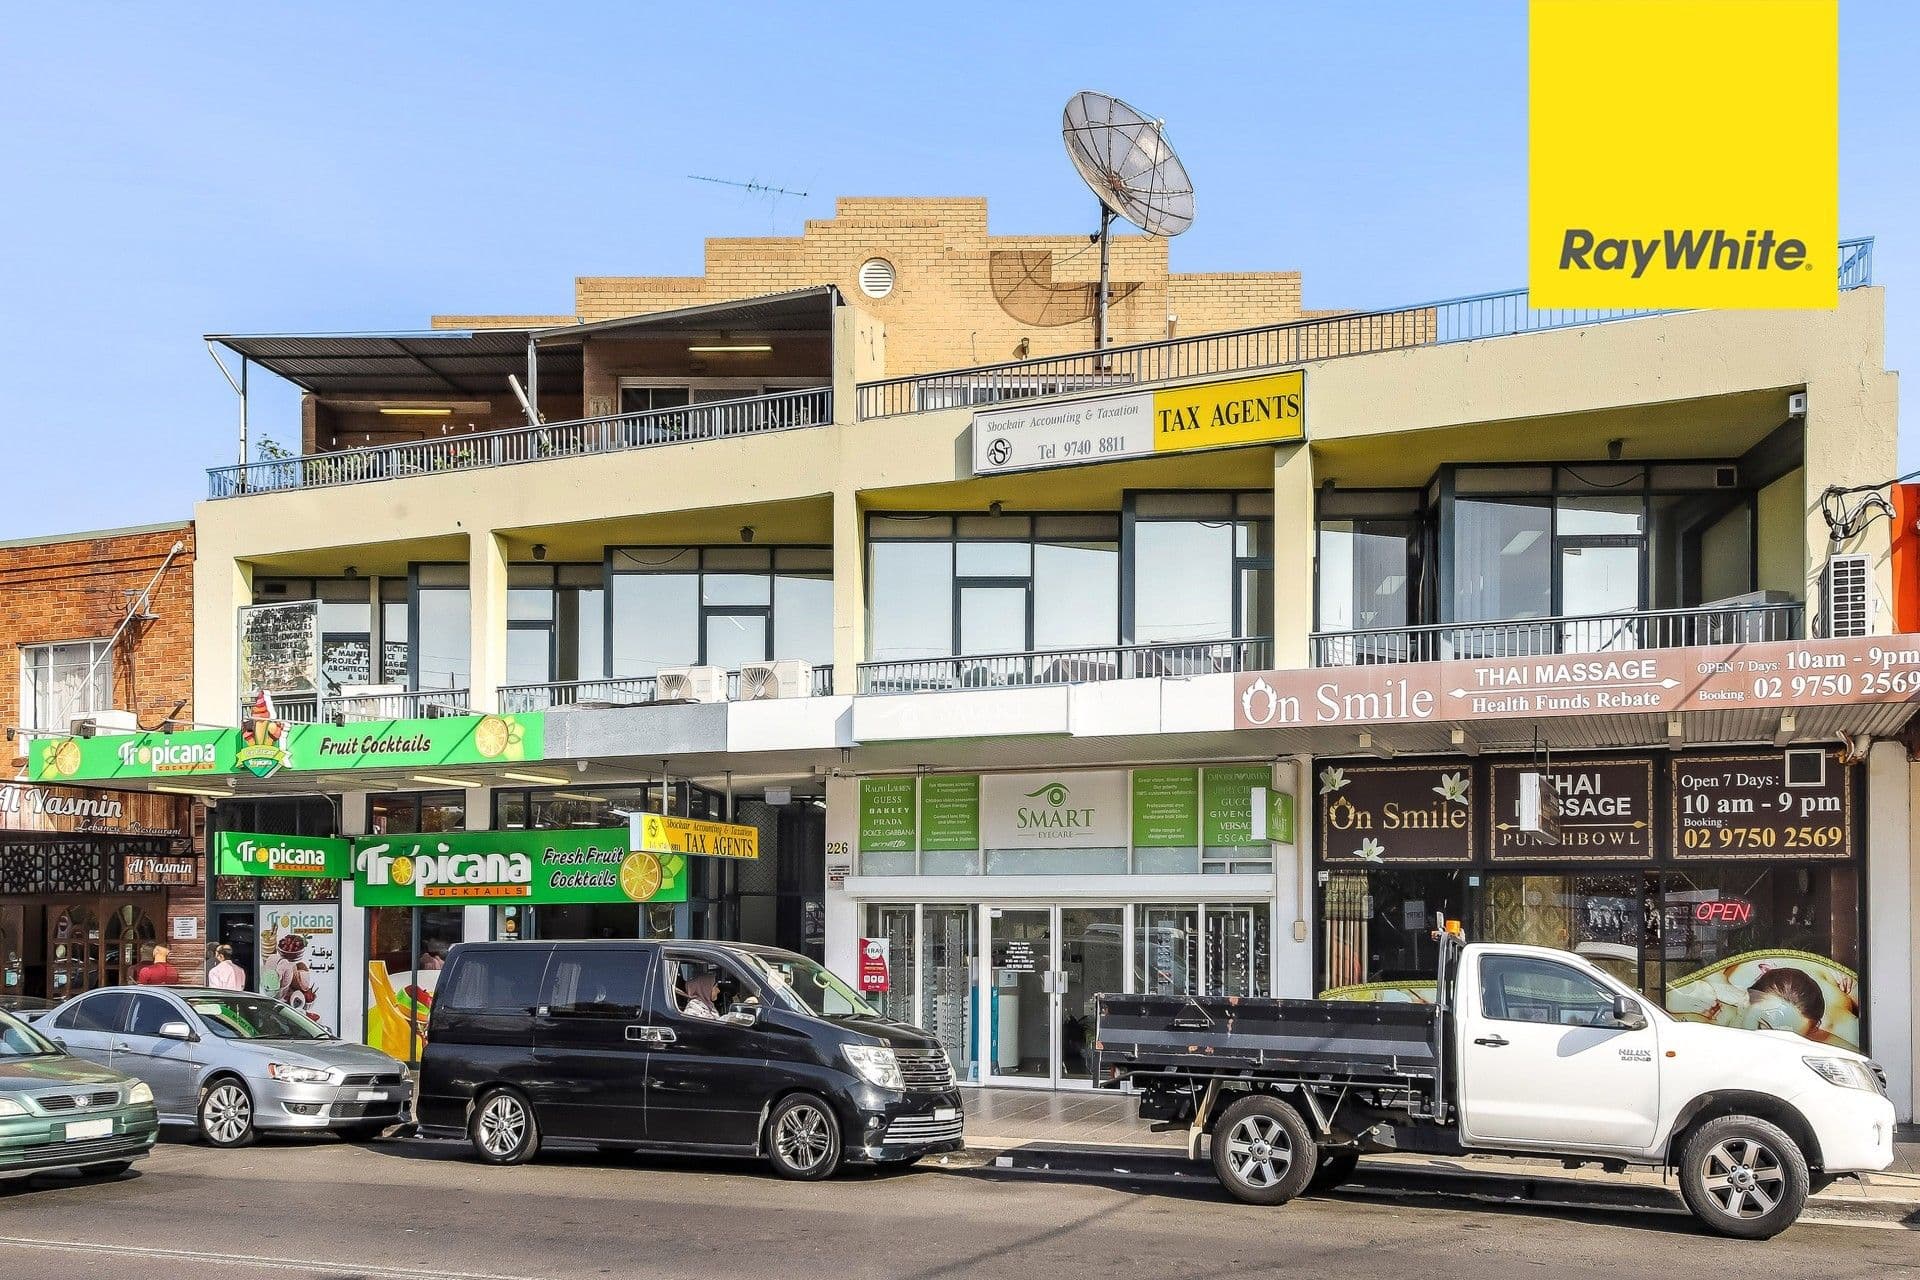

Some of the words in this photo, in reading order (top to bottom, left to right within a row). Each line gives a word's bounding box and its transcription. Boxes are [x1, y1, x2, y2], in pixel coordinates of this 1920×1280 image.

[986, 418, 1026, 433] Shockair
[1029, 411, 1082, 428] Accounting
[1085, 409, 1093, 420] &
[1097, 404, 1139, 420] Taxation
[1158, 405, 1200, 433] TAX
[1211, 393, 1299, 428] AGENTS
[1038, 443, 1056, 460] Tel
[1064, 439, 1092, 457] 9740
[1098, 435, 1126, 453] 8811
[1696, 661, 1734, 674] OPEN
[1738, 661, 1745, 673] 7
[1748, 660, 1781, 672] Days:
[1786, 650, 1846, 670] 10am
[1475, 665, 1528, 686] THAI
[1535, 659, 1658, 684] MASSAGE
[1753, 677, 1783, 699] 02
[1790, 674, 1852, 697] 9750
[1860, 670, 1920, 695] 2569
[1316, 679, 1434, 722] Smile
[1472, 695, 1529, 713] Health
[1535, 693, 1590, 710] Funds
[1596, 692, 1661, 708] Rebate
[1699, 690, 1745, 702] Booking
[319, 737, 358, 755] Fruit
[361, 733, 431, 753] Cocktails
[118, 739, 216, 773] Tropicana
[1681, 774, 1719, 788] Open
[1723, 774, 1732, 787] 7
[0, 785, 20, 812] Al
[24, 787, 124, 818] Yasmin
[873, 795, 902, 804] GUESS
[1221, 797, 1250, 806] GUCC
[1683, 794, 1710, 814] 10
[1717, 797, 1754, 814] am
[1778, 792, 1793, 812] 9
[1801, 796, 1841, 818] pm
[869, 807, 910, 815] OAKLEY
[1017, 807, 1095, 829] SMART
[1383, 801, 1467, 830] Smile
[74, 818, 122, 833] Lebanese
[125, 820, 182, 835] Restaurant
[873, 818, 903, 826] PRADA
[1220, 821, 1252, 831] VERSAC
[1684, 817, 1723, 828] Booking
[1038, 830, 1073, 839] EYECARE
[1217, 833, 1252, 843] ESCAD
[1683, 828, 1712, 849] 02
[1719, 828, 1776, 848] 9750
[1784, 826, 1842, 848] 2569
[237, 840, 325, 870] Tropicana
[685, 833, 706, 854] TAX
[712, 836, 754, 858] AGENTS
[827, 842, 848, 855] 226
[128, 858, 143, 874] Al
[145, 858, 193, 875] Yasmin
[542, 848, 583, 866] Fresh
[585, 847, 625, 865] Fruit
[356, 843, 532, 897] Tropicana
[549, 870, 617, 889] Cocktails
[426, 887, 524, 897] COCKTAILS
[267, 911, 333, 933] Tropicana
[1696, 903, 1751, 922] OPEN
